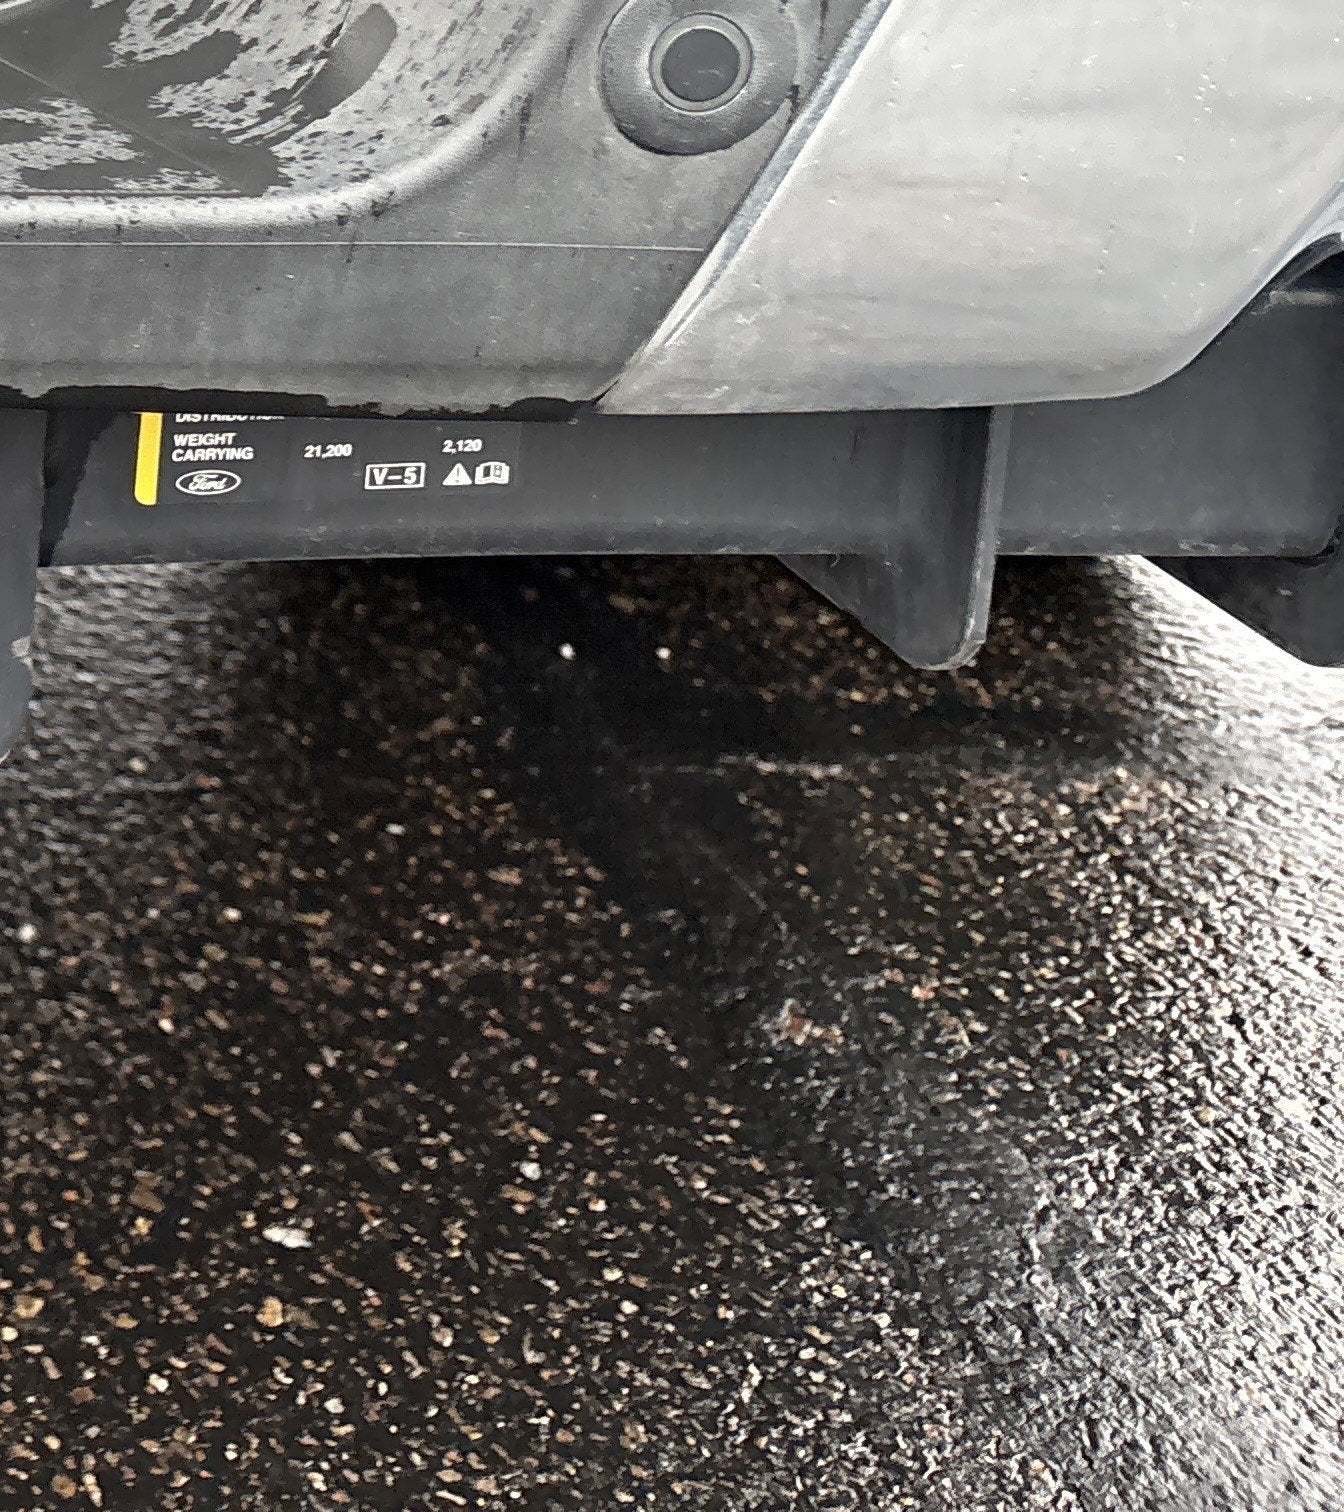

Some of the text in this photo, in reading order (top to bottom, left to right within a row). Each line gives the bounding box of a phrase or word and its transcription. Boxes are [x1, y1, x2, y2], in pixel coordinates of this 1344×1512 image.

[173, 432, 237, 447] WEIGHT
[441, 439, 483, 455] 2,120
[171, 446, 254, 462] CARRYING
[303, 443, 353, 459] 21,200
[372, 467, 417, 485] V-5
